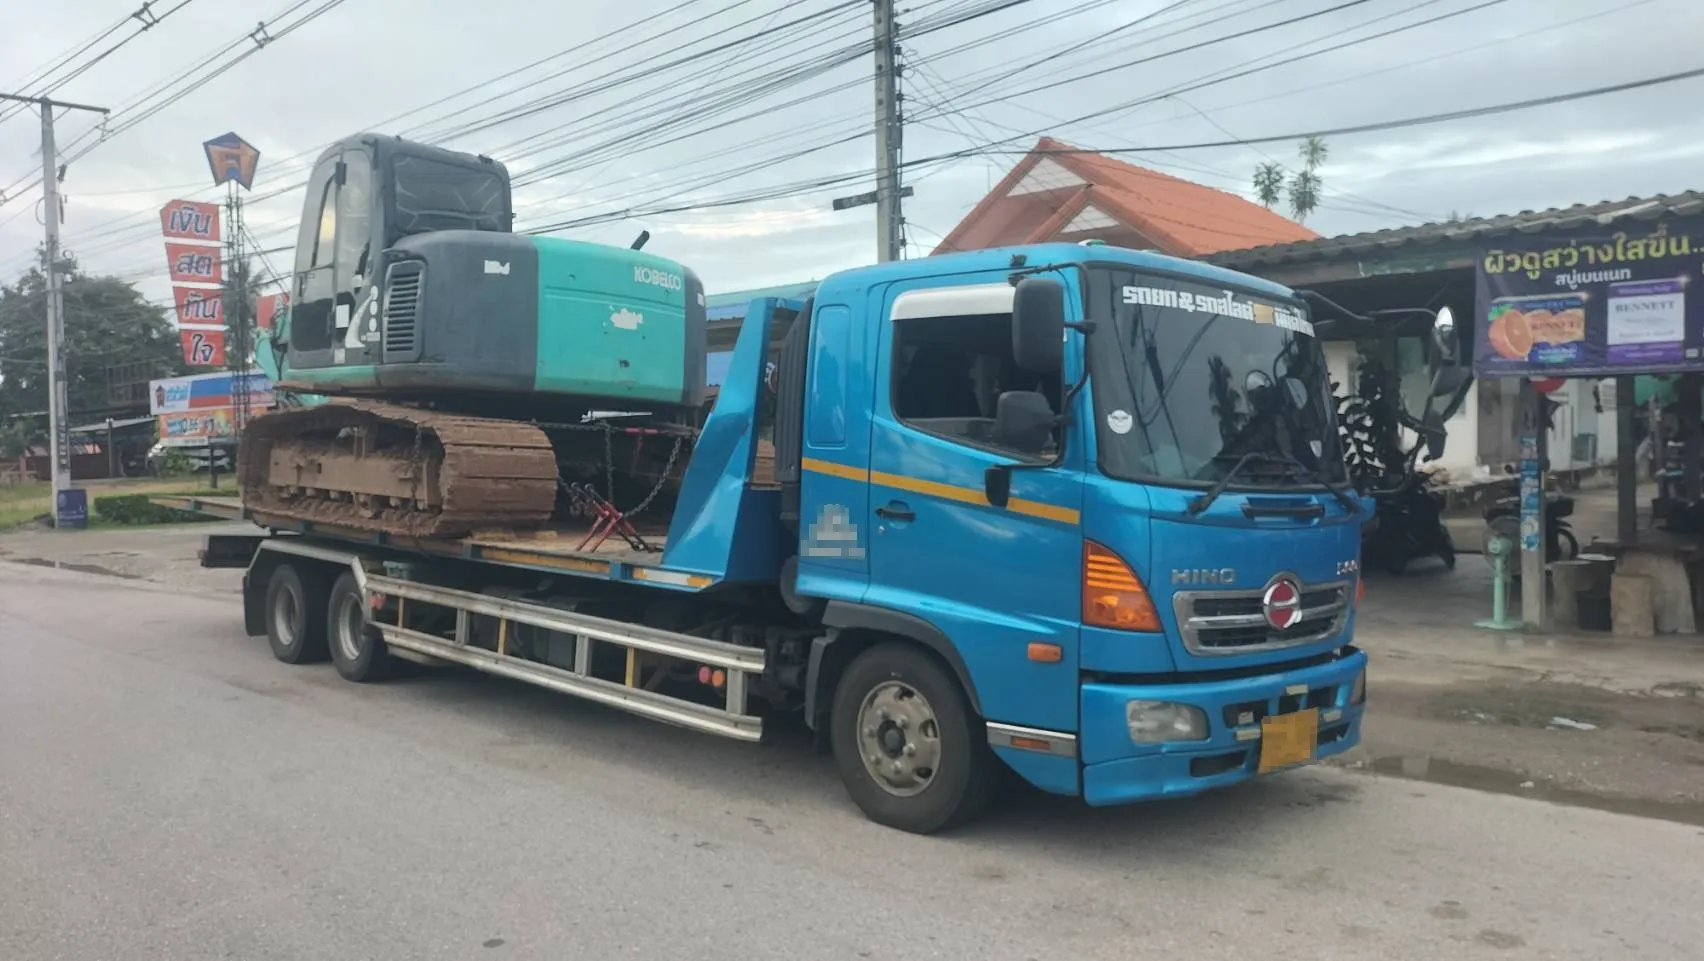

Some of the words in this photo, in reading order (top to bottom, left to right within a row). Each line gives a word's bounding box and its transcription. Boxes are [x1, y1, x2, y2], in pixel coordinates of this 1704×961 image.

[169, 206, 212, 235] เงิน
[633, 266, 682, 290] KOBELCO
[1615, 300, 1676, 313] BENNETT
[191, 332, 214, 363] ใจ
[1171, 567, 1236, 584] HINO
